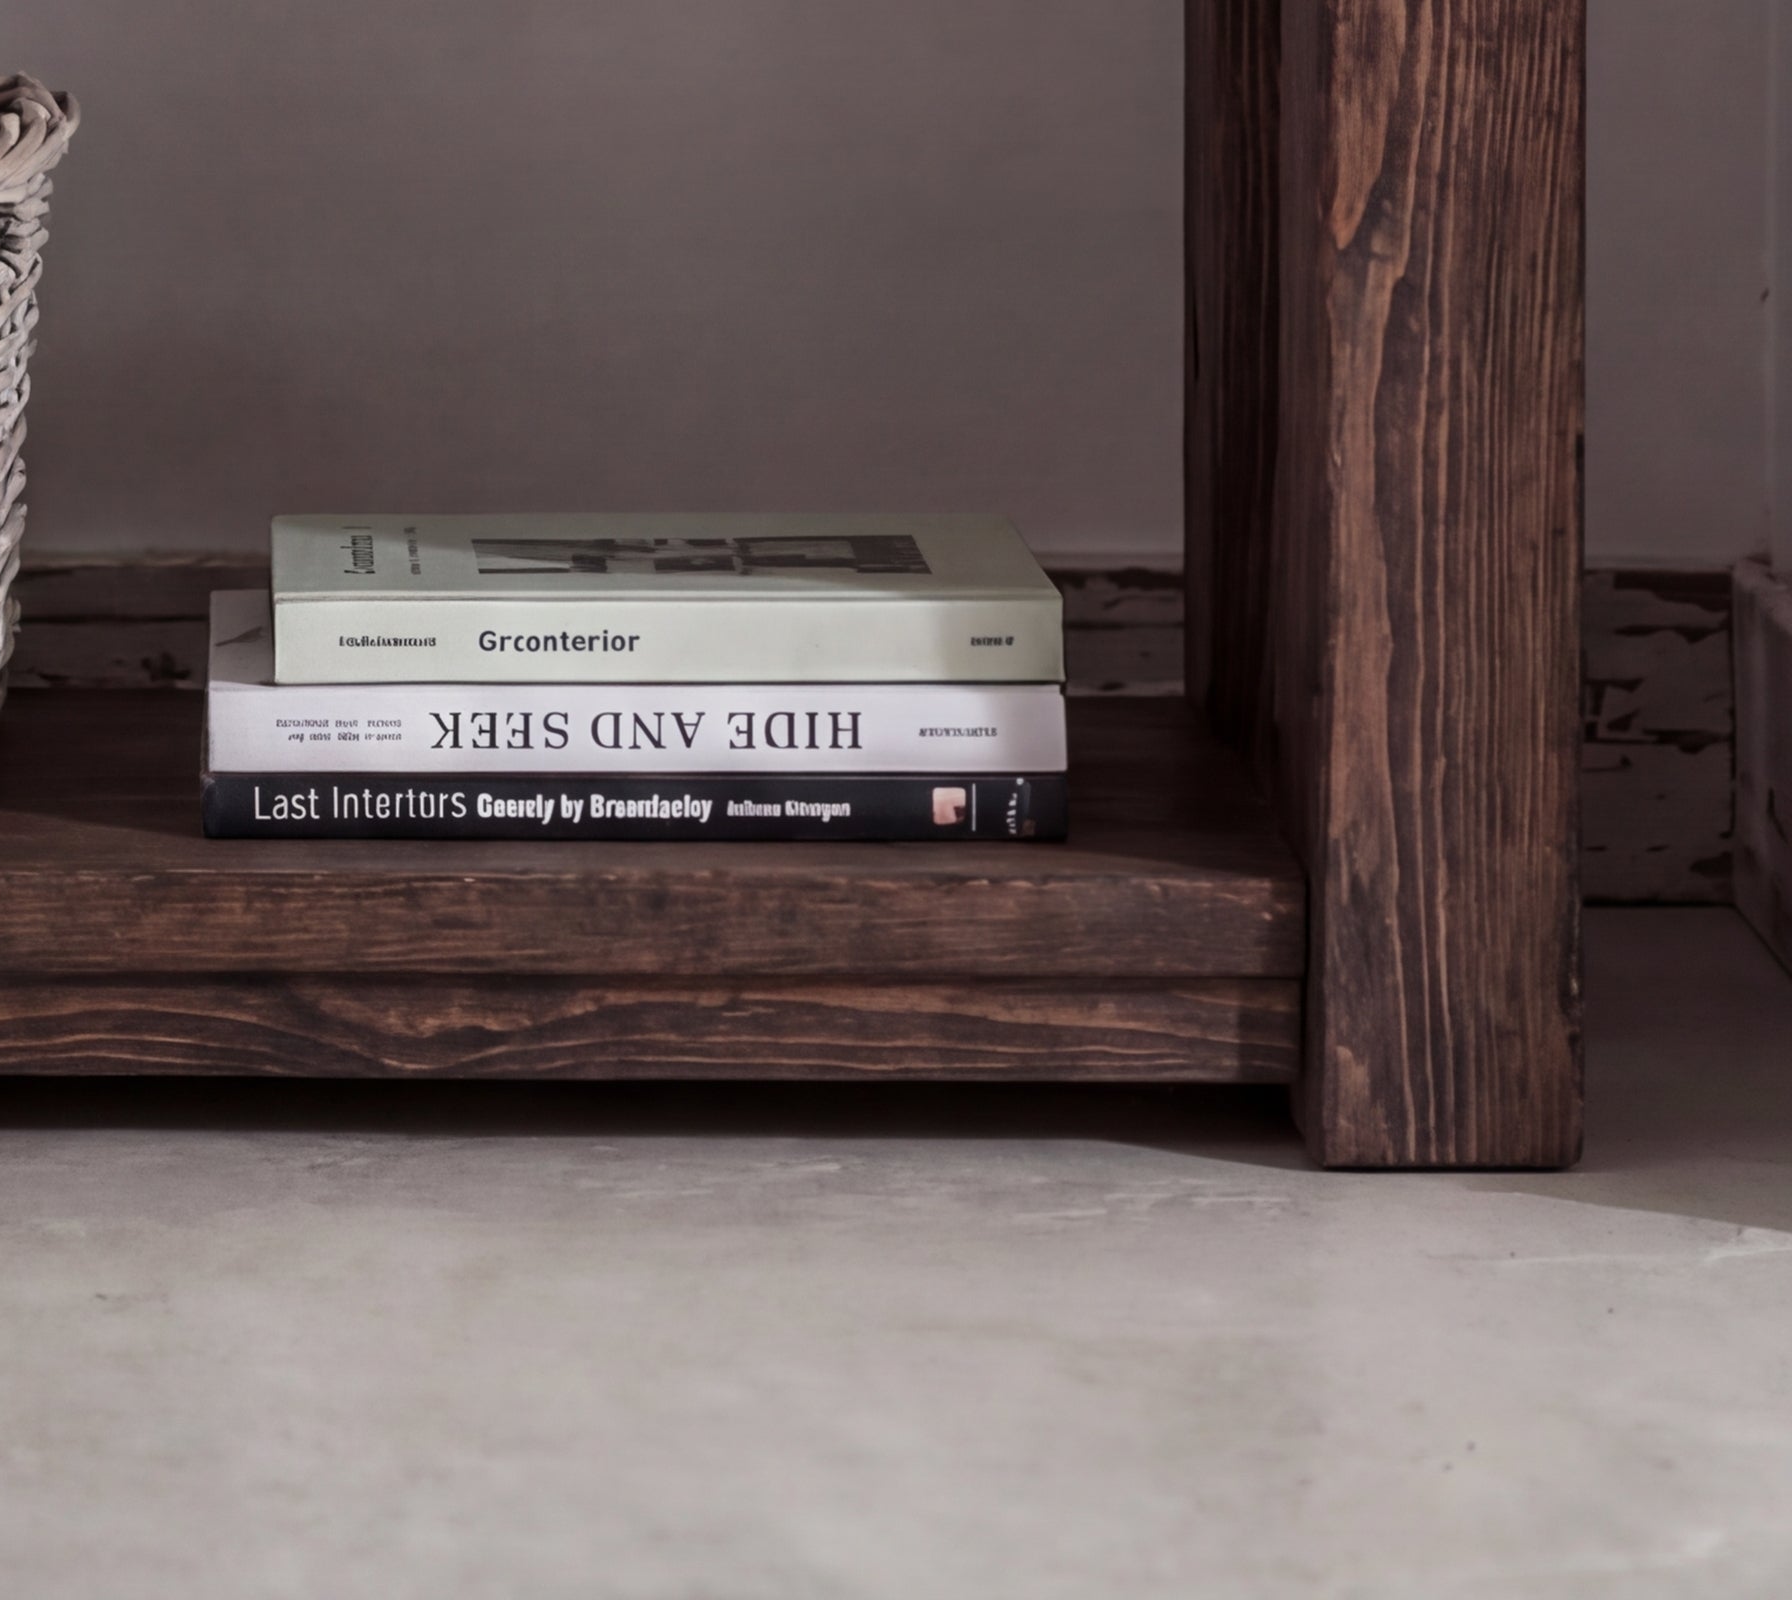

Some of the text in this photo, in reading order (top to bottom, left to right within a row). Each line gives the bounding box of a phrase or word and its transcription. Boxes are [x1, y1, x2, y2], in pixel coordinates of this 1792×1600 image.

[477, 629, 641, 653] Grconterior
[428, 710, 864, 751] HIDE AND SEEK
[254, 786, 320, 820] Last
[560, 793, 584, 824] by
